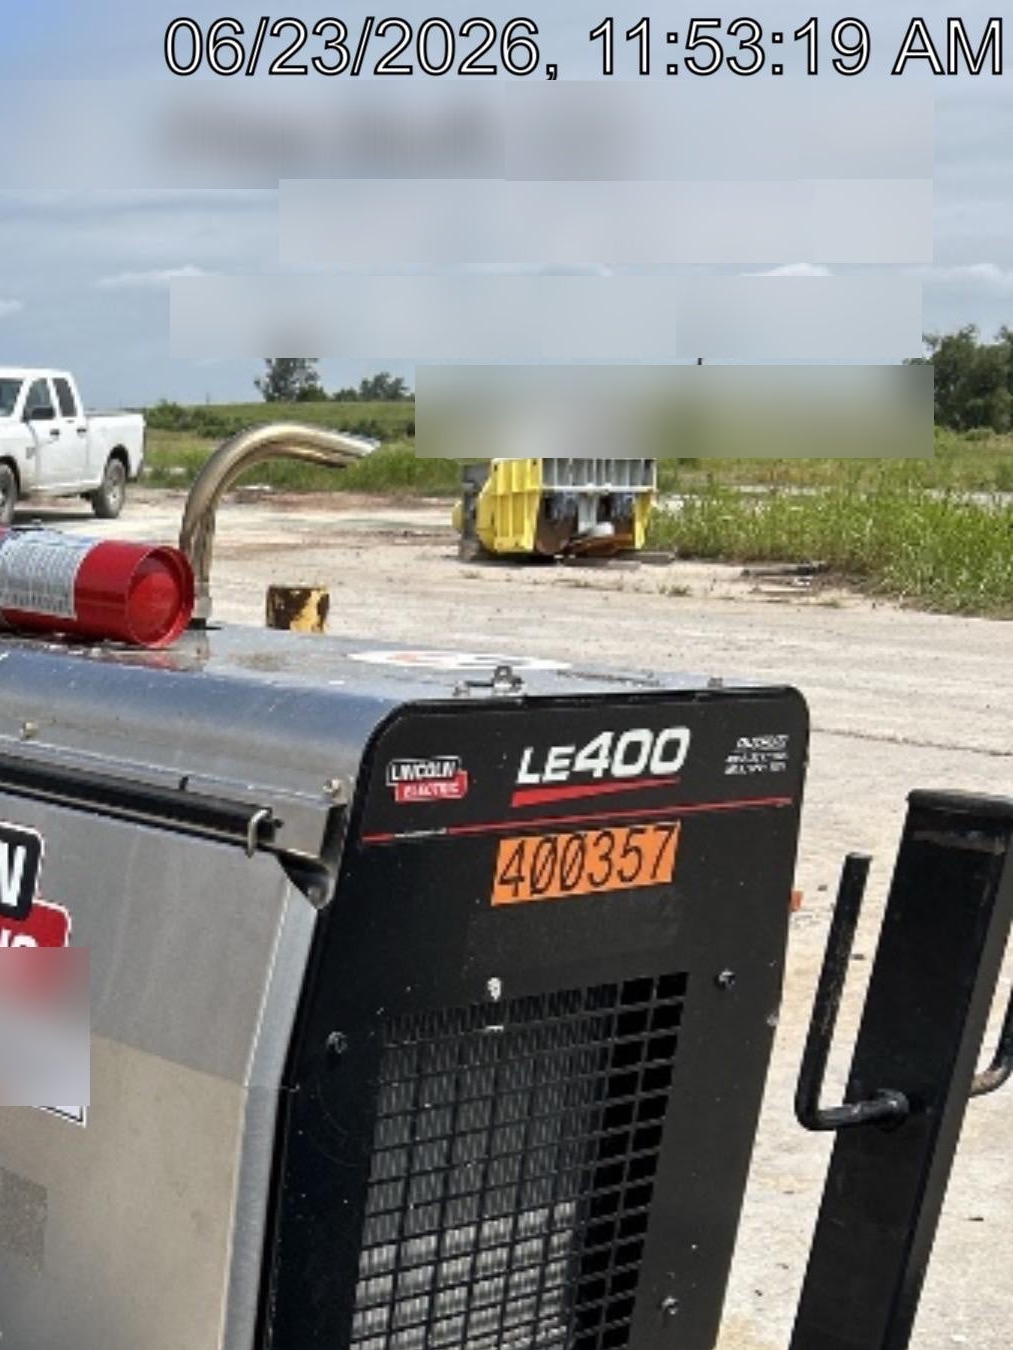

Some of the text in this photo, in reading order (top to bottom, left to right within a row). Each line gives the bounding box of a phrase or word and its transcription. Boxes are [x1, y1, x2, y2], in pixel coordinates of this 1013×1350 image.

[391, 761, 457, 781] LINCOLN
[517, 726, 691, 783] LE400
[498, 828, 676, 896] 400357
